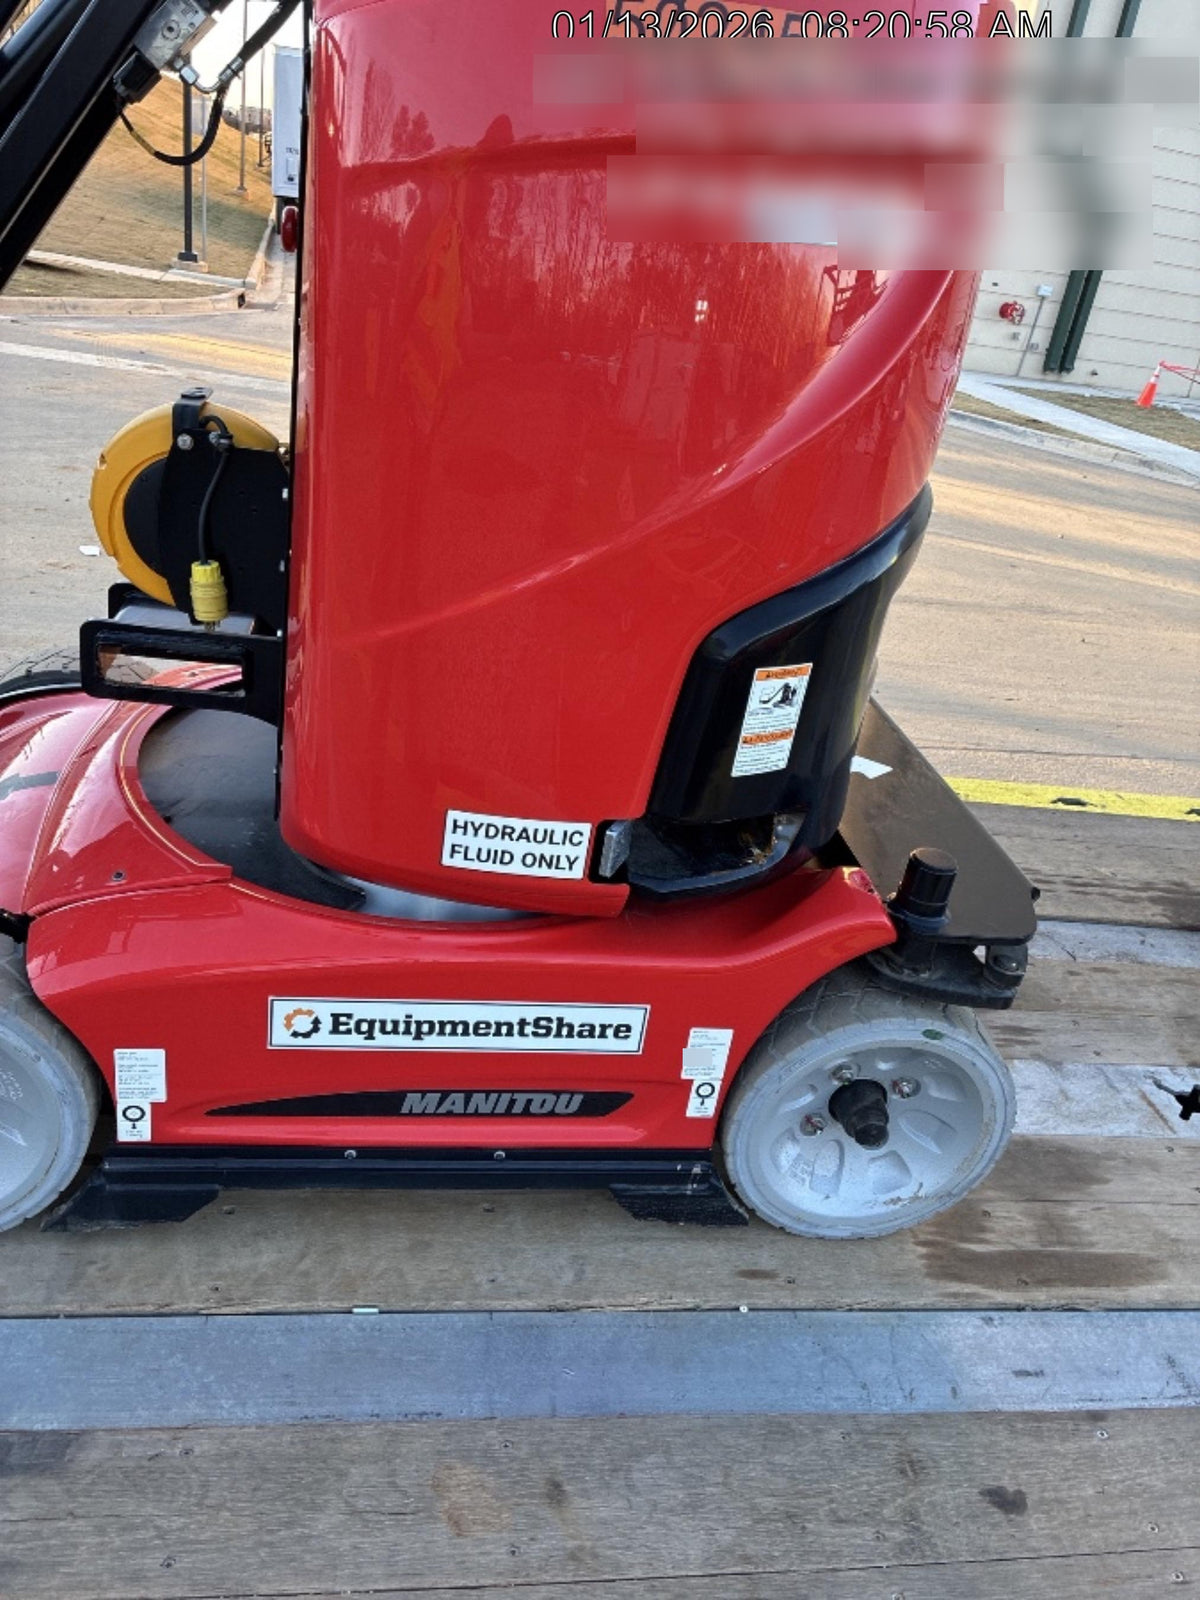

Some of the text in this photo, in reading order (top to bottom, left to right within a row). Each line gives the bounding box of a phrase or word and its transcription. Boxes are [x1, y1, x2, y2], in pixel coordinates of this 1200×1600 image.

[451, 818, 584, 847] HYDRAULIC
[449, 843, 579, 872] FLUID ONLY
[328, 1012, 633, 1041] EquipmentShare
[400, 1092, 585, 1115] MANITOU
